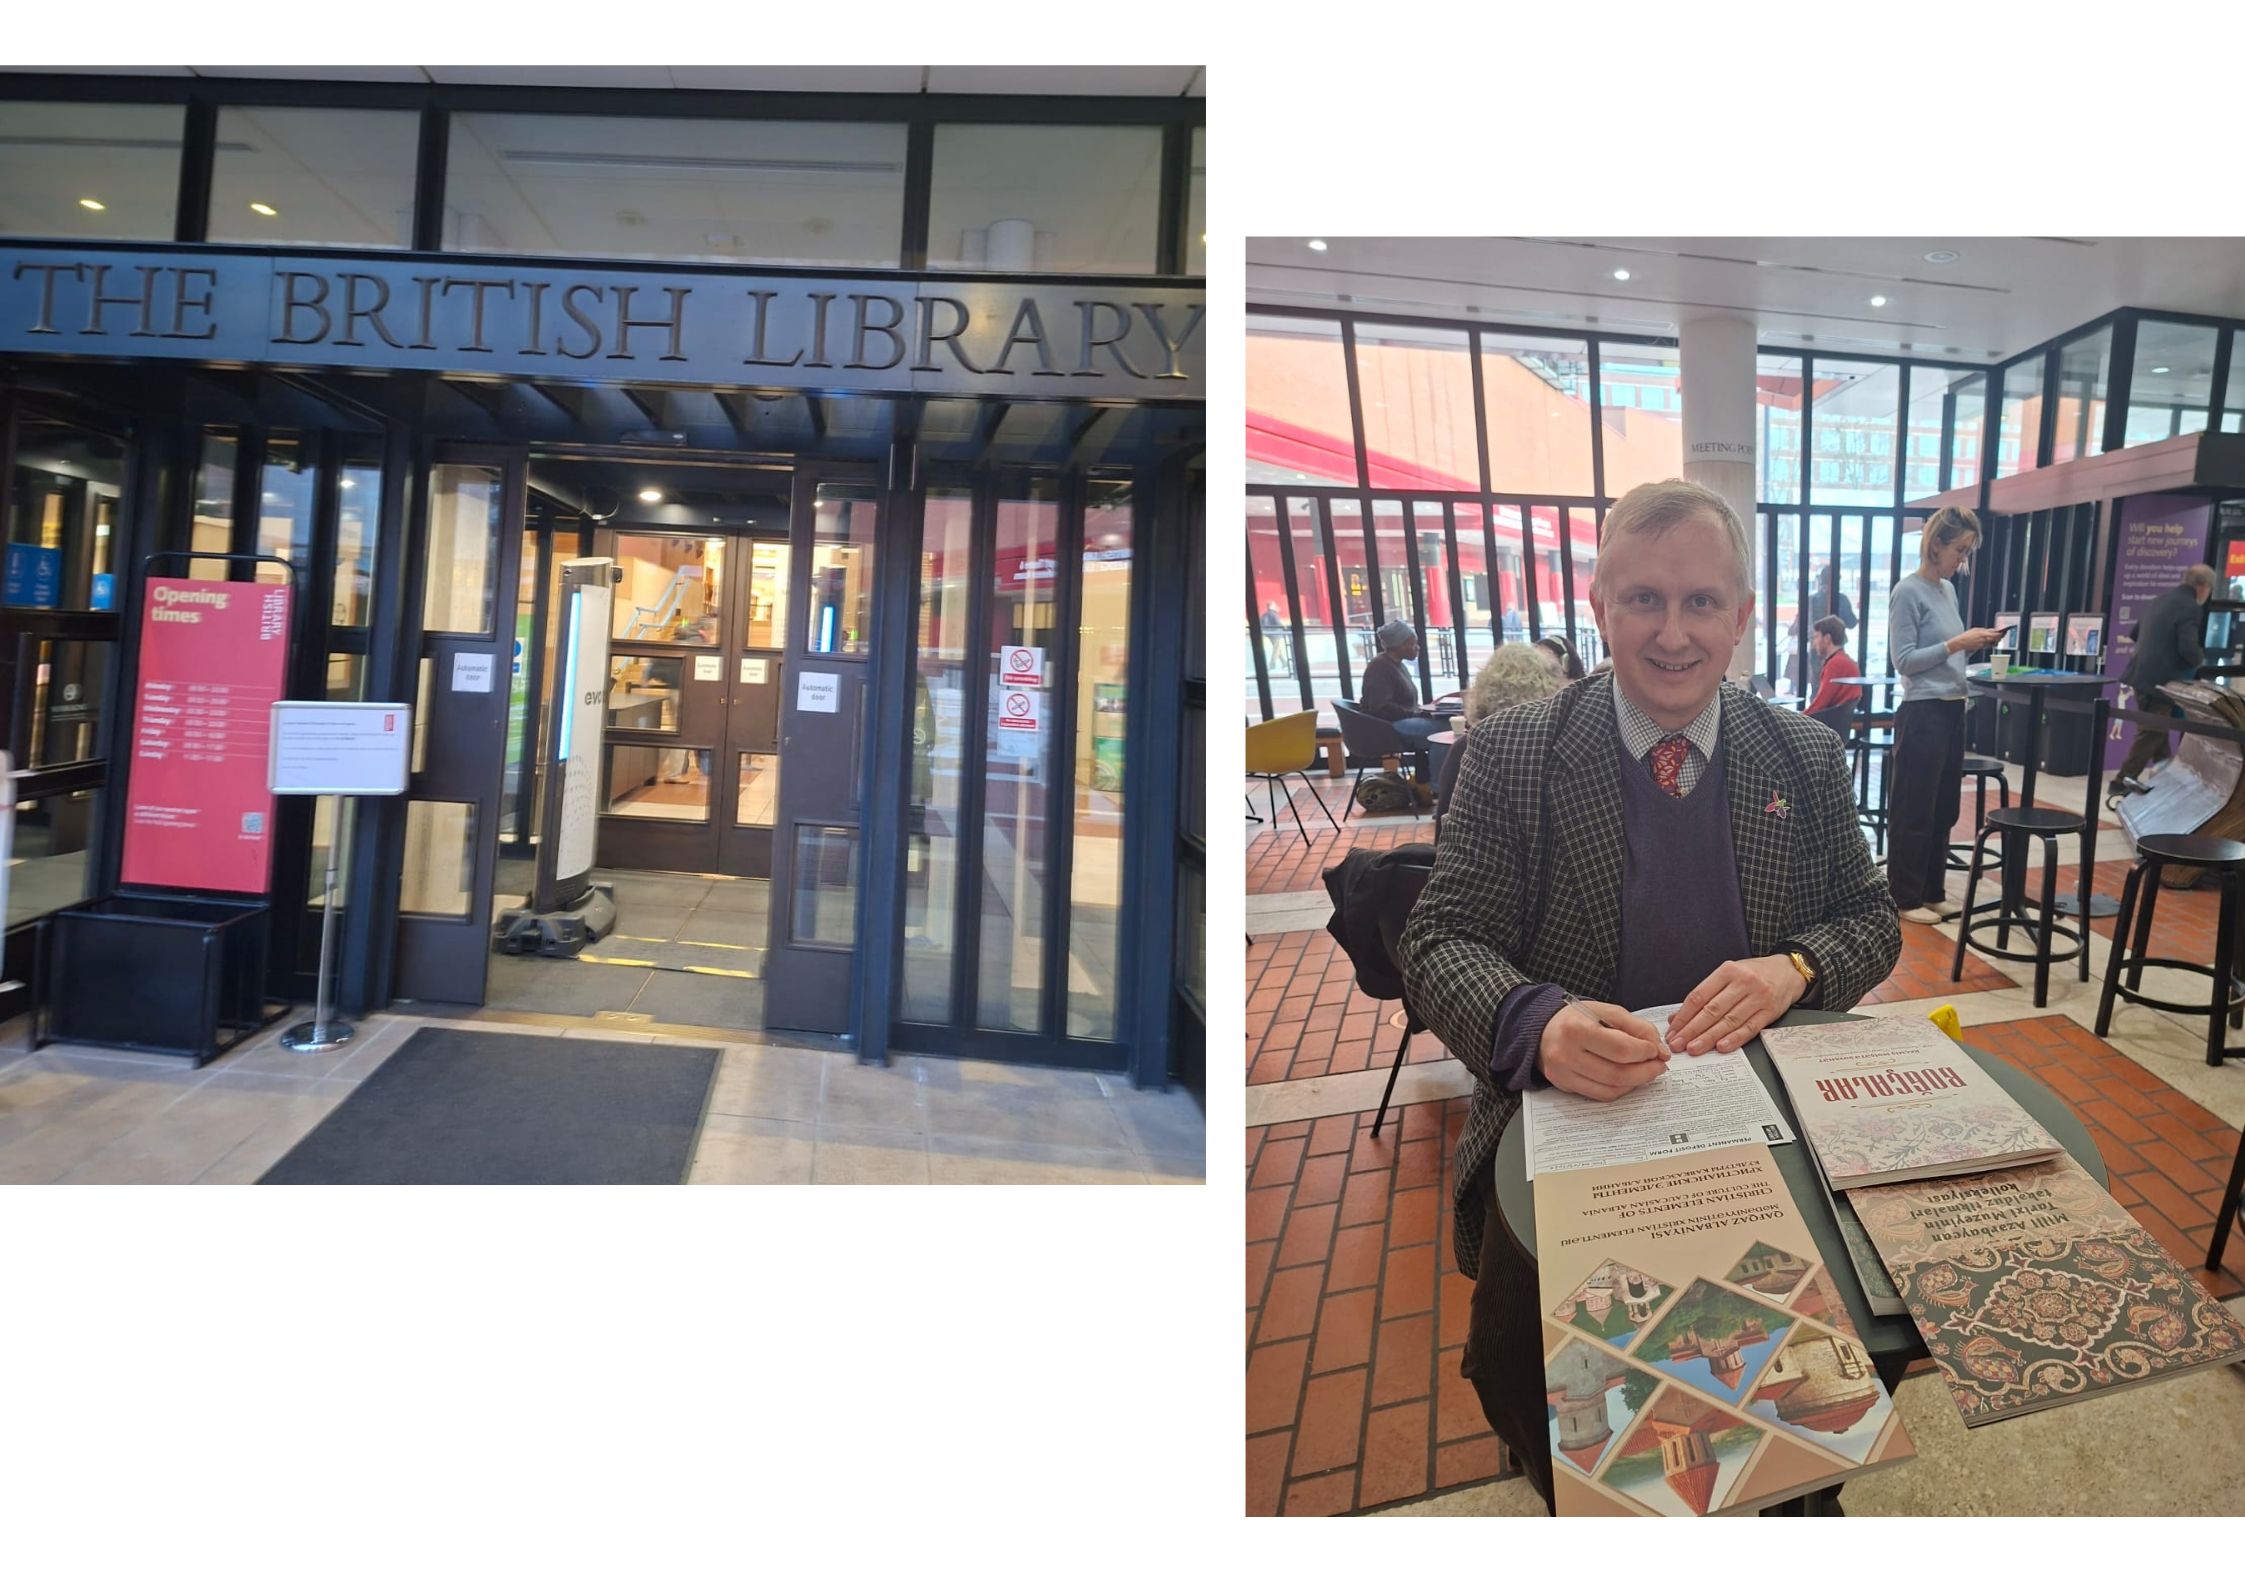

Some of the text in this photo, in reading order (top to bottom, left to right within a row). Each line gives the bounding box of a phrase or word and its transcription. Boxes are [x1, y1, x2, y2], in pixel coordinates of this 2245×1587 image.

[13, 260, 1206, 380] THE BRITISH LIBRARY
[1691, 443, 1737, 453] MEETING
[2129, 523, 2183, 535] Will you help
[2127, 536, 2198, 547] start new journeys
[2126, 548, 2178, 558] of discovery?
[154, 586, 229, 610] Opening
[152, 606, 202, 623] times
[260, 595, 273, 641] BRITISH
[273, 589, 286, 635] LIBRARY
[802, 684, 834, 693] Automatic
[811, 693, 826, 701] door
[1815, 1067, 1967, 1102] BOĞÇALAR
[1675, 1143, 1705, 1152] DEPOSIT
[1708, 1137, 1752, 1147] PERMANENT
[1592, 1160, 1760, 1191] КУЛЬТУРЫ КАВКАЗСКОЙ АЛБАНИИ
[1593, 1166, 1763, 1199] ХРИСТИАНСКИЕ ЭЛЕМЕНТЫ
[1705, 1184, 1749, 1195] CULTURE
[1751, 1181, 1769, 1189] THE
[1927, 1183, 2020, 1203] kolleksiyası
[1639, 1199, 1703, 1217] ELEMENTS
[1909, 1188, 2052, 1219] təkəlduz tikmələri
[1618, 1210, 1635, 1219] OF
[1924, 1201, 2057, 1230] Tarixi Muzeyinin
[1651, 1210, 1783, 1239] QAFQAZ ALBANİYASI
[1931, 1213, 2069, 1243] Milli Azərbaycan
